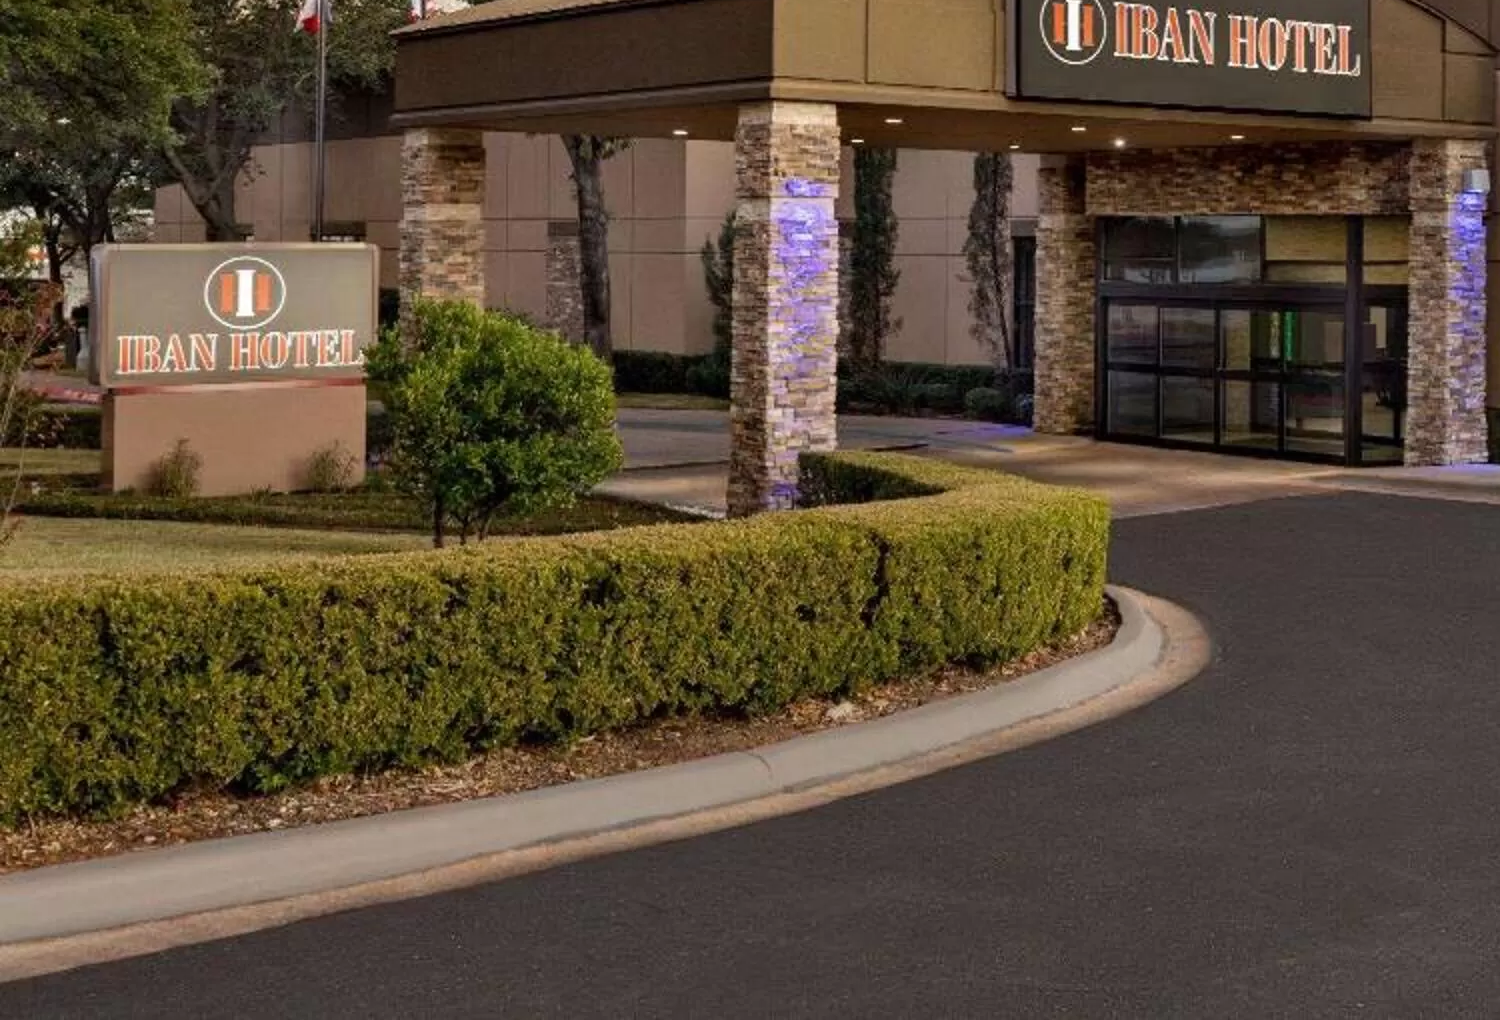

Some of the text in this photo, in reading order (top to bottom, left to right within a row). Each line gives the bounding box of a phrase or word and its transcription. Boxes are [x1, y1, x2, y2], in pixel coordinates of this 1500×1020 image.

[1113, 1, 1361, 77] IBAN HOTEL
[116, 329, 364, 375] IBAN HOTEL
